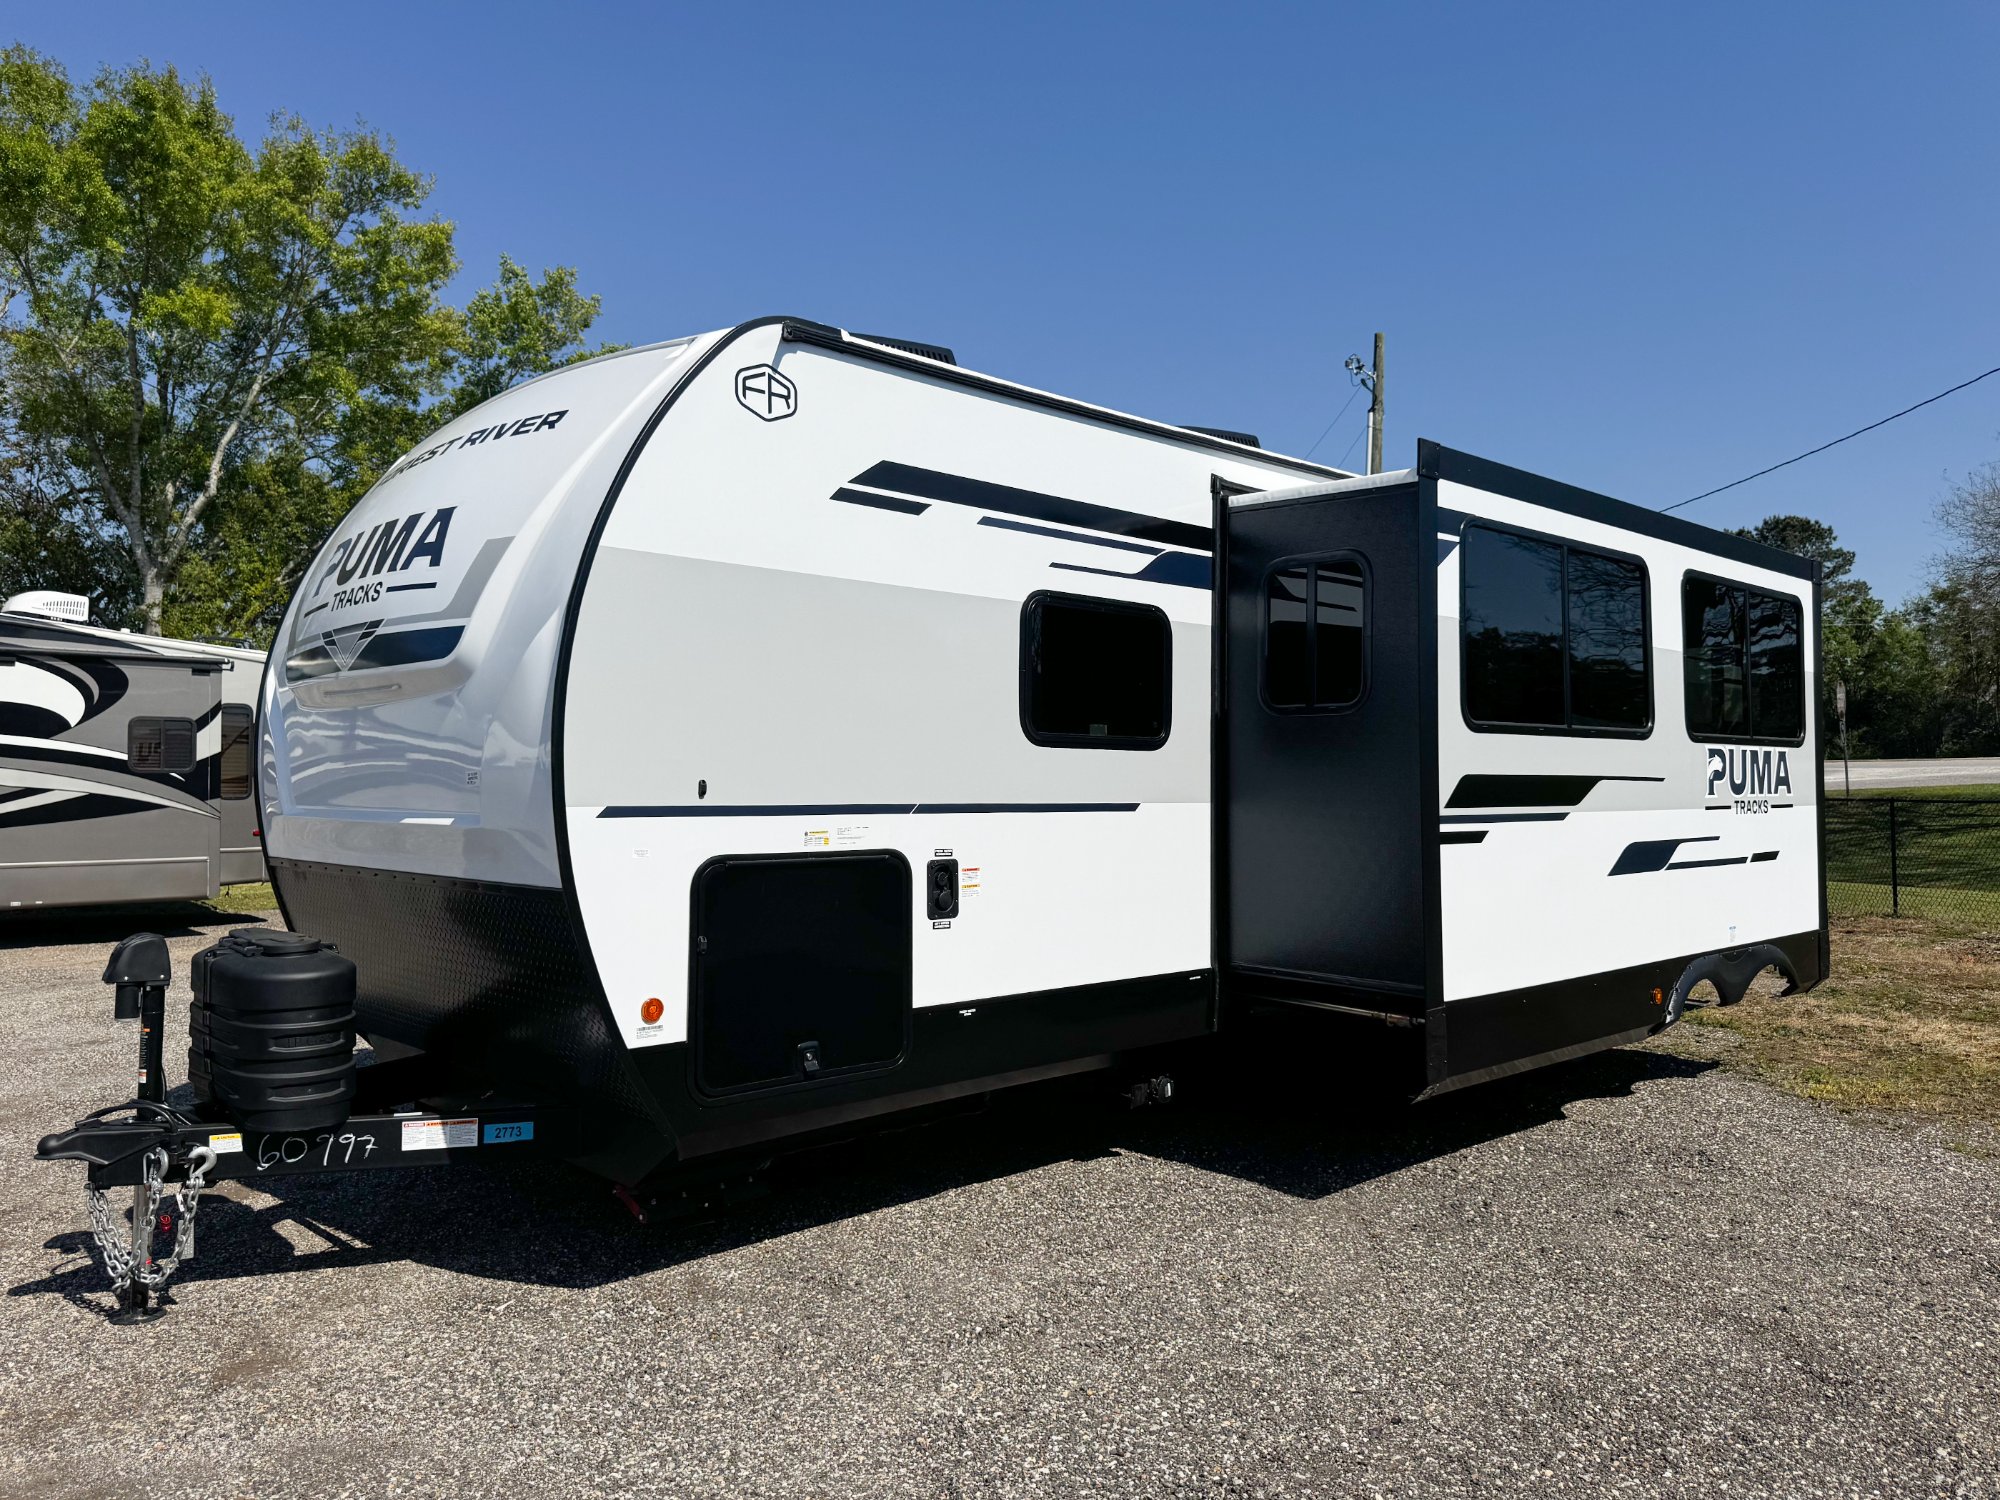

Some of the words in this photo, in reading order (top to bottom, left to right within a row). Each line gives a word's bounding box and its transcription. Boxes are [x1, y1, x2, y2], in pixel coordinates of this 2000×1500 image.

[741, 371, 792, 415] FR
[374, 436, 464, 489] REST
[458, 409, 570, 450] RIVER
[311, 505, 459, 599] PUMA
[330, 581, 384, 612] TRACKS
[1705, 747, 1793, 797] PUMA
[1733, 799, 1769, 815] TRACKS
[494, 1126, 523, 1139] 2773
